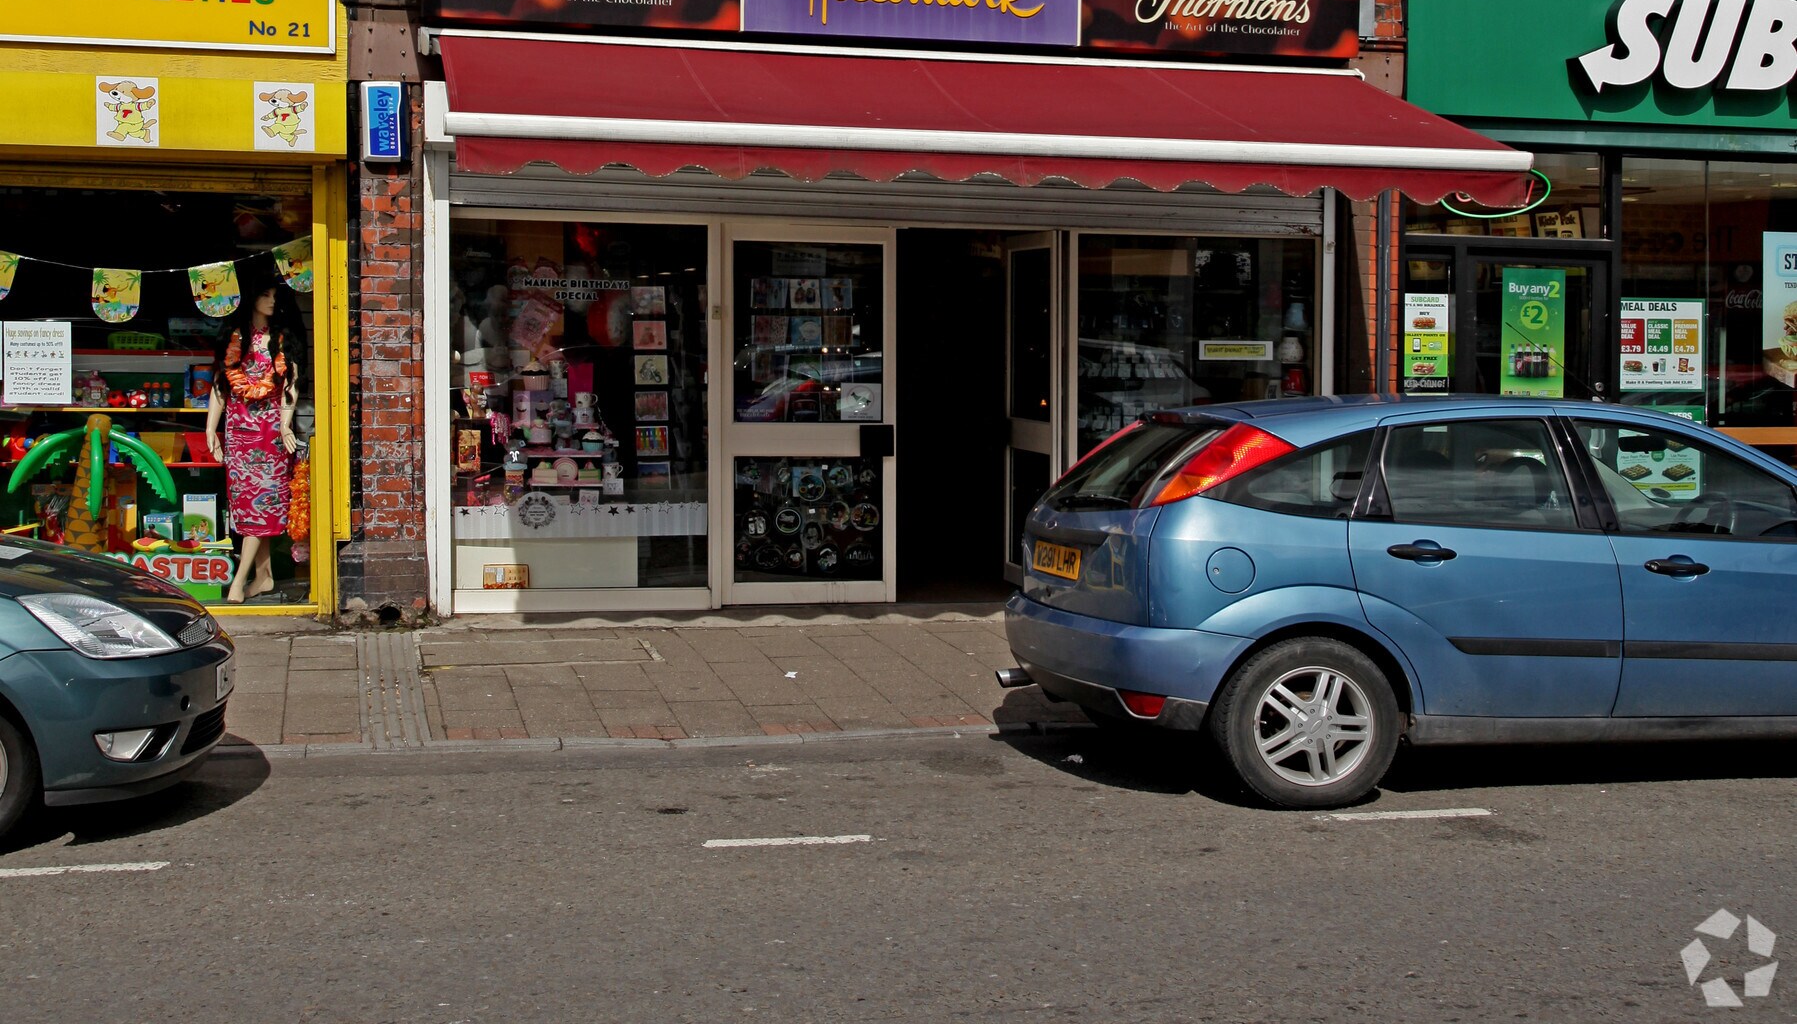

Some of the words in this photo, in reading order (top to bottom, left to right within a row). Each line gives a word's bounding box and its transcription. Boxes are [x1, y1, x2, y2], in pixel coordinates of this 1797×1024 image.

[249, 20, 277, 36] No
[288, 23, 311, 37] 21
[1164, 22, 1182, 31] the
[1185, 22, 1202, 32] Art
[1205, 22, 1217, 32] of
[1220, 23, 1238, 33] the
[1241, 24, 1301, 36] Chocolatier
[373, 89, 392, 152] waveley
[524, 278, 567, 288] MAKING
[570, 279, 630, 290] BIRTHDAYS
[1508, 282, 1529, 296] Buy
[1530, 285, 1550, 296] any
[1548, 280, 1560, 298] 2
[555, 291, 598, 301] SPECIAL
[1620, 302, 1645, 312] MEAL
[1648, 302, 1678, 312] DEALS
[1522, 305, 1544, 324] £2
[5, 327, 17, 340] Huge
[40, 327, 51, 340] fancy
[52, 327, 64, 338] dress
[1621, 345, 1642, 353] £3.79
[1647, 345, 1669, 353] £4.49
[1674, 345, 1695, 353] £4.79
